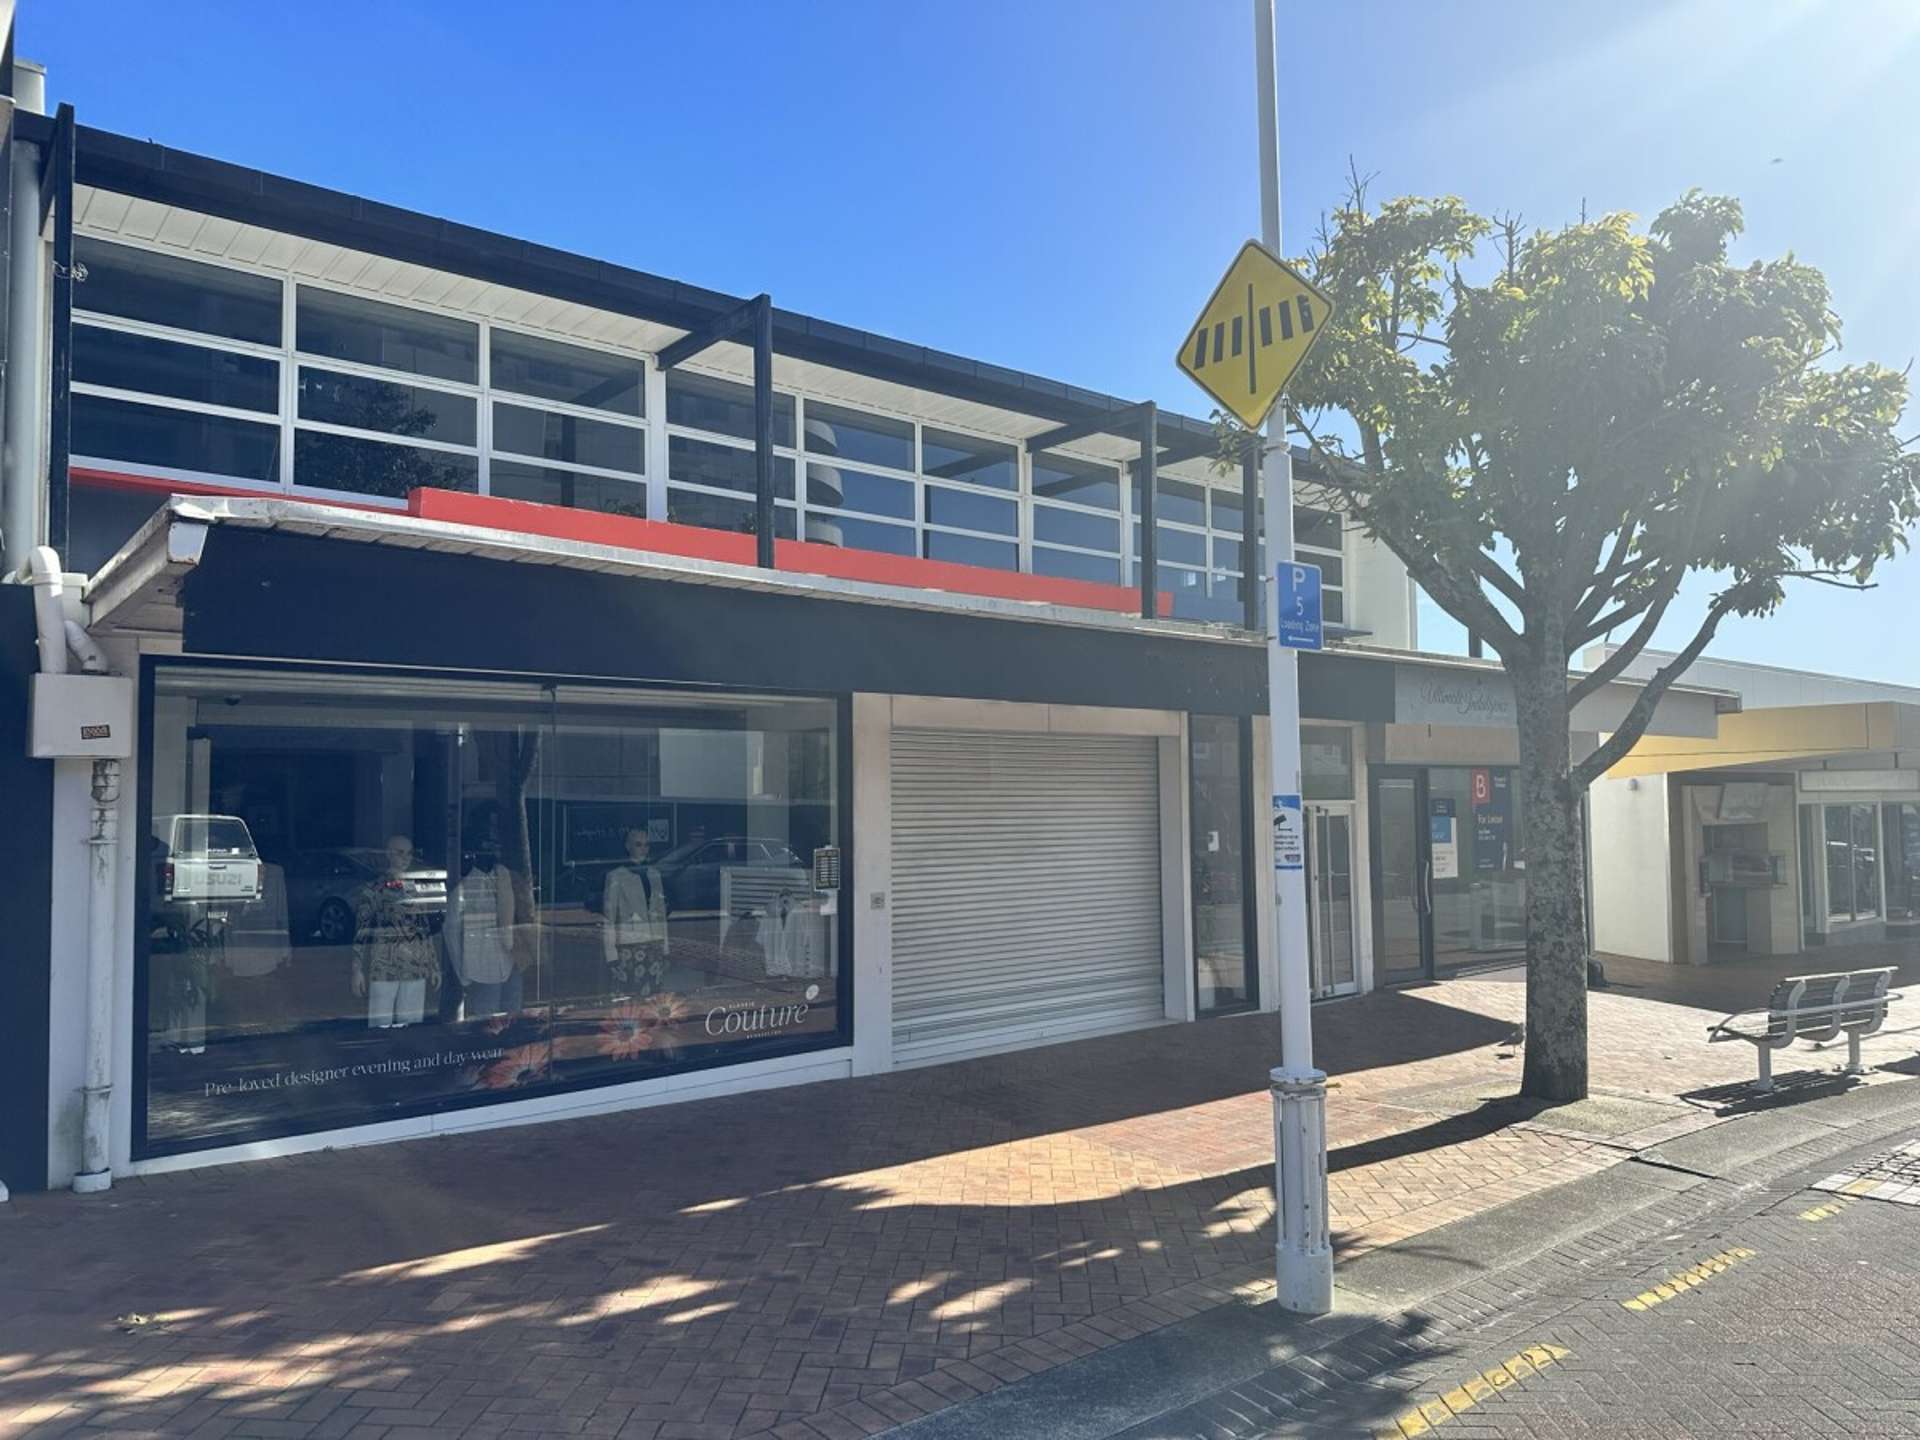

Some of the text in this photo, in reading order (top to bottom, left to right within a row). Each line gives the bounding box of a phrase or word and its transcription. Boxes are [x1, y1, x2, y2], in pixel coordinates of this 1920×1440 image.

[1293, 567, 1306, 592] P
[1296, 596, 1304, 616] 5
[1476, 774, 1486, 798] B
[705, 1003, 808, 1036] Couture
[284, 1067, 349, 1085] designer
[352, 1058, 410, 1076] evening
[414, 1053, 440, 1068] and
[443, 1051, 465, 1066] day
[471, 1048, 504, 1060] wear
